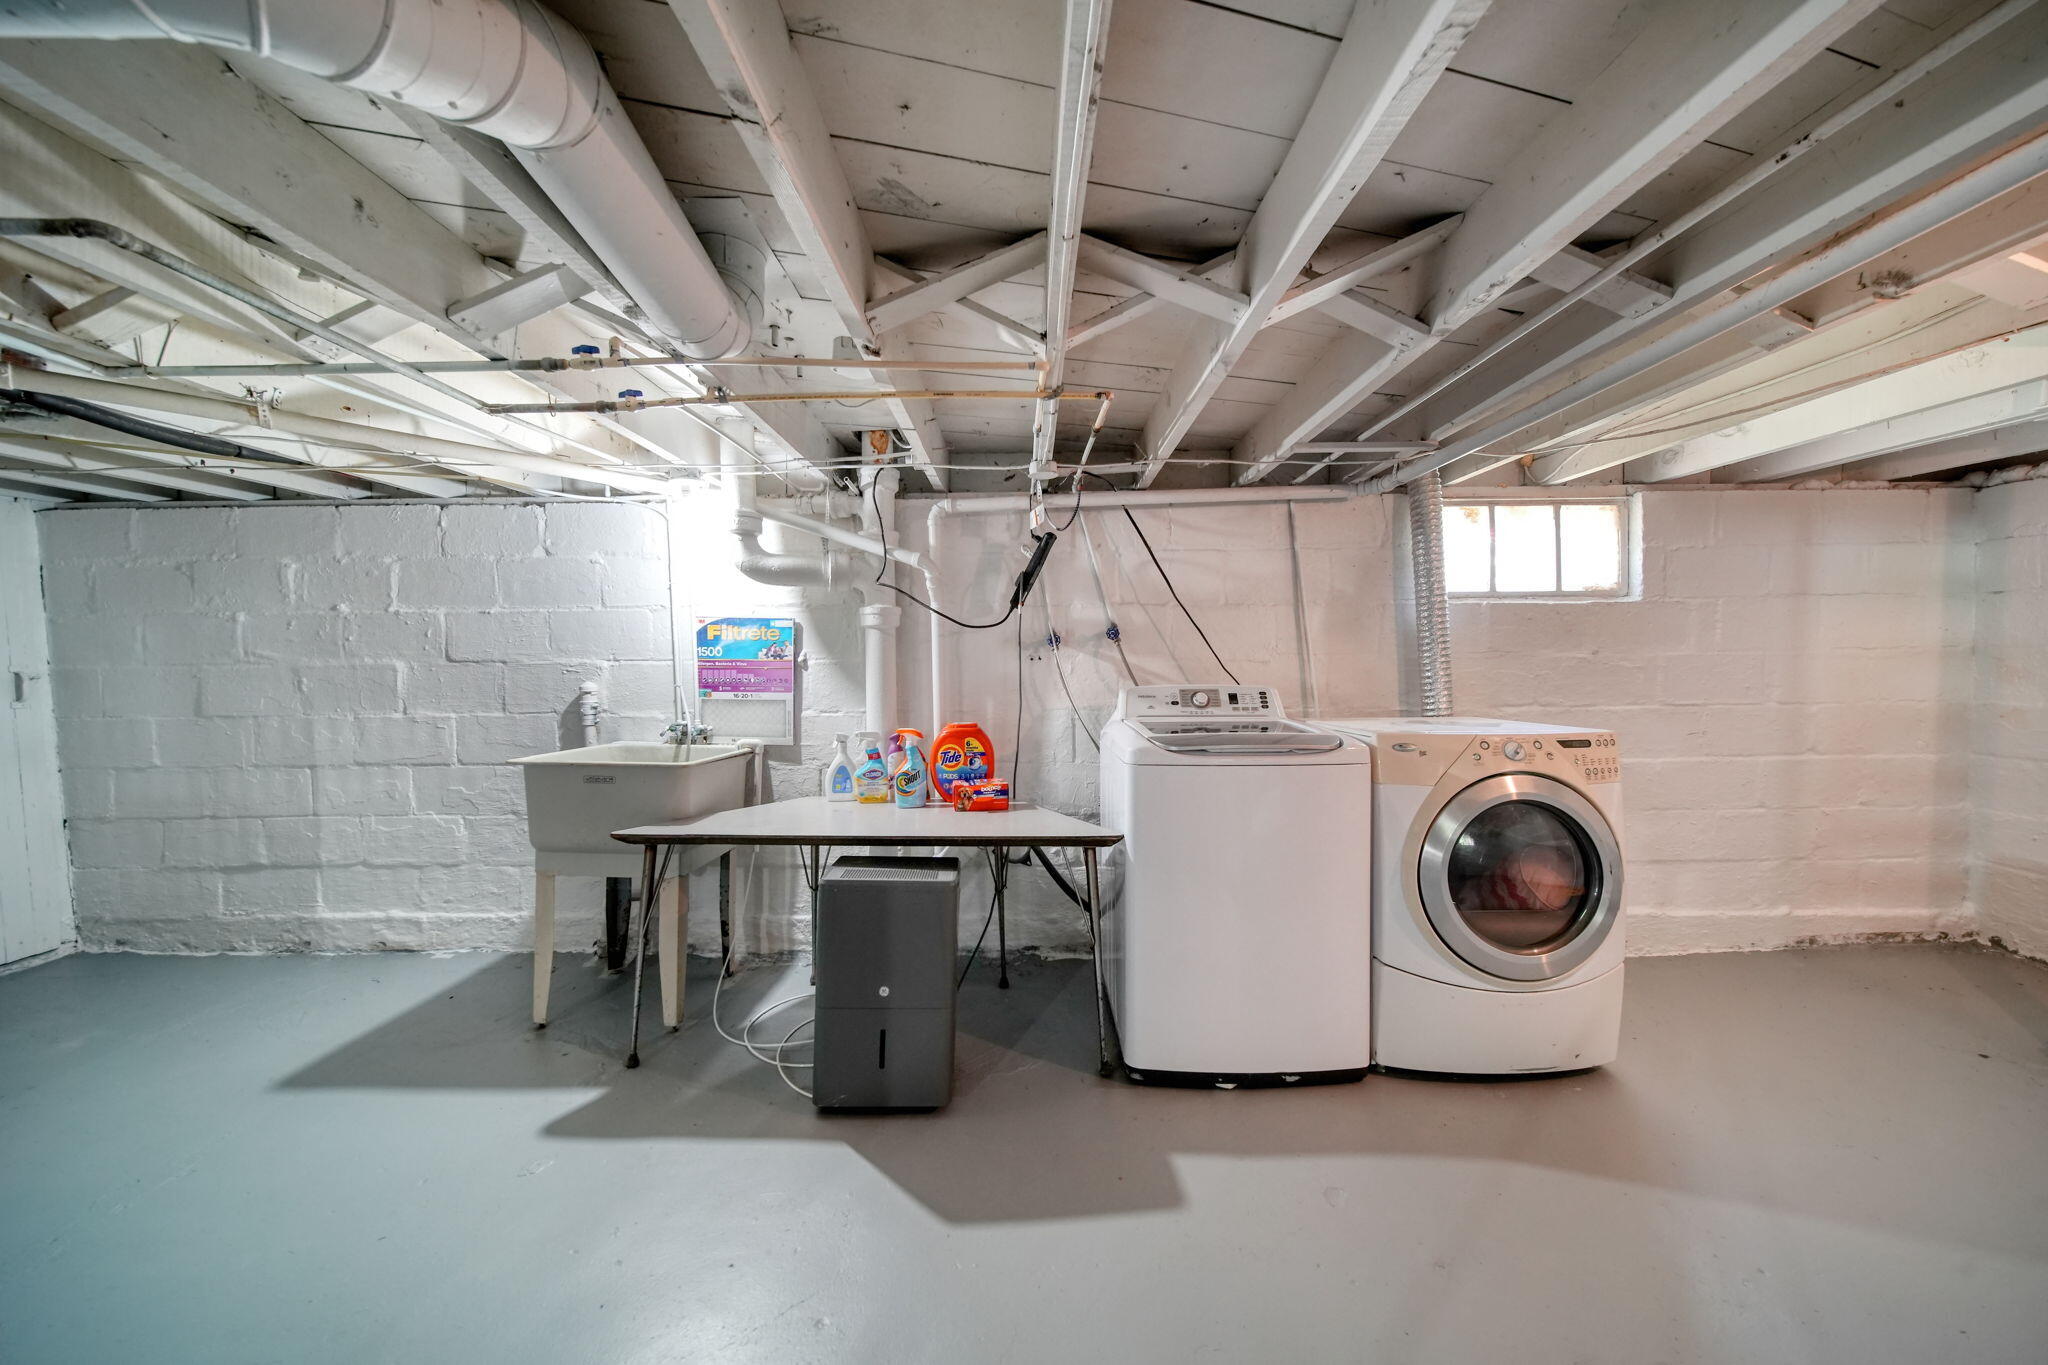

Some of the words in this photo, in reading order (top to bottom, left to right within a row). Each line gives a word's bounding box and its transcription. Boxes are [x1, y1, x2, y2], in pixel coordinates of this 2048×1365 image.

[707, 624, 780, 641] Filtrete
[697, 647, 723, 657] 1500
[940, 750, 962, 766] Tide
